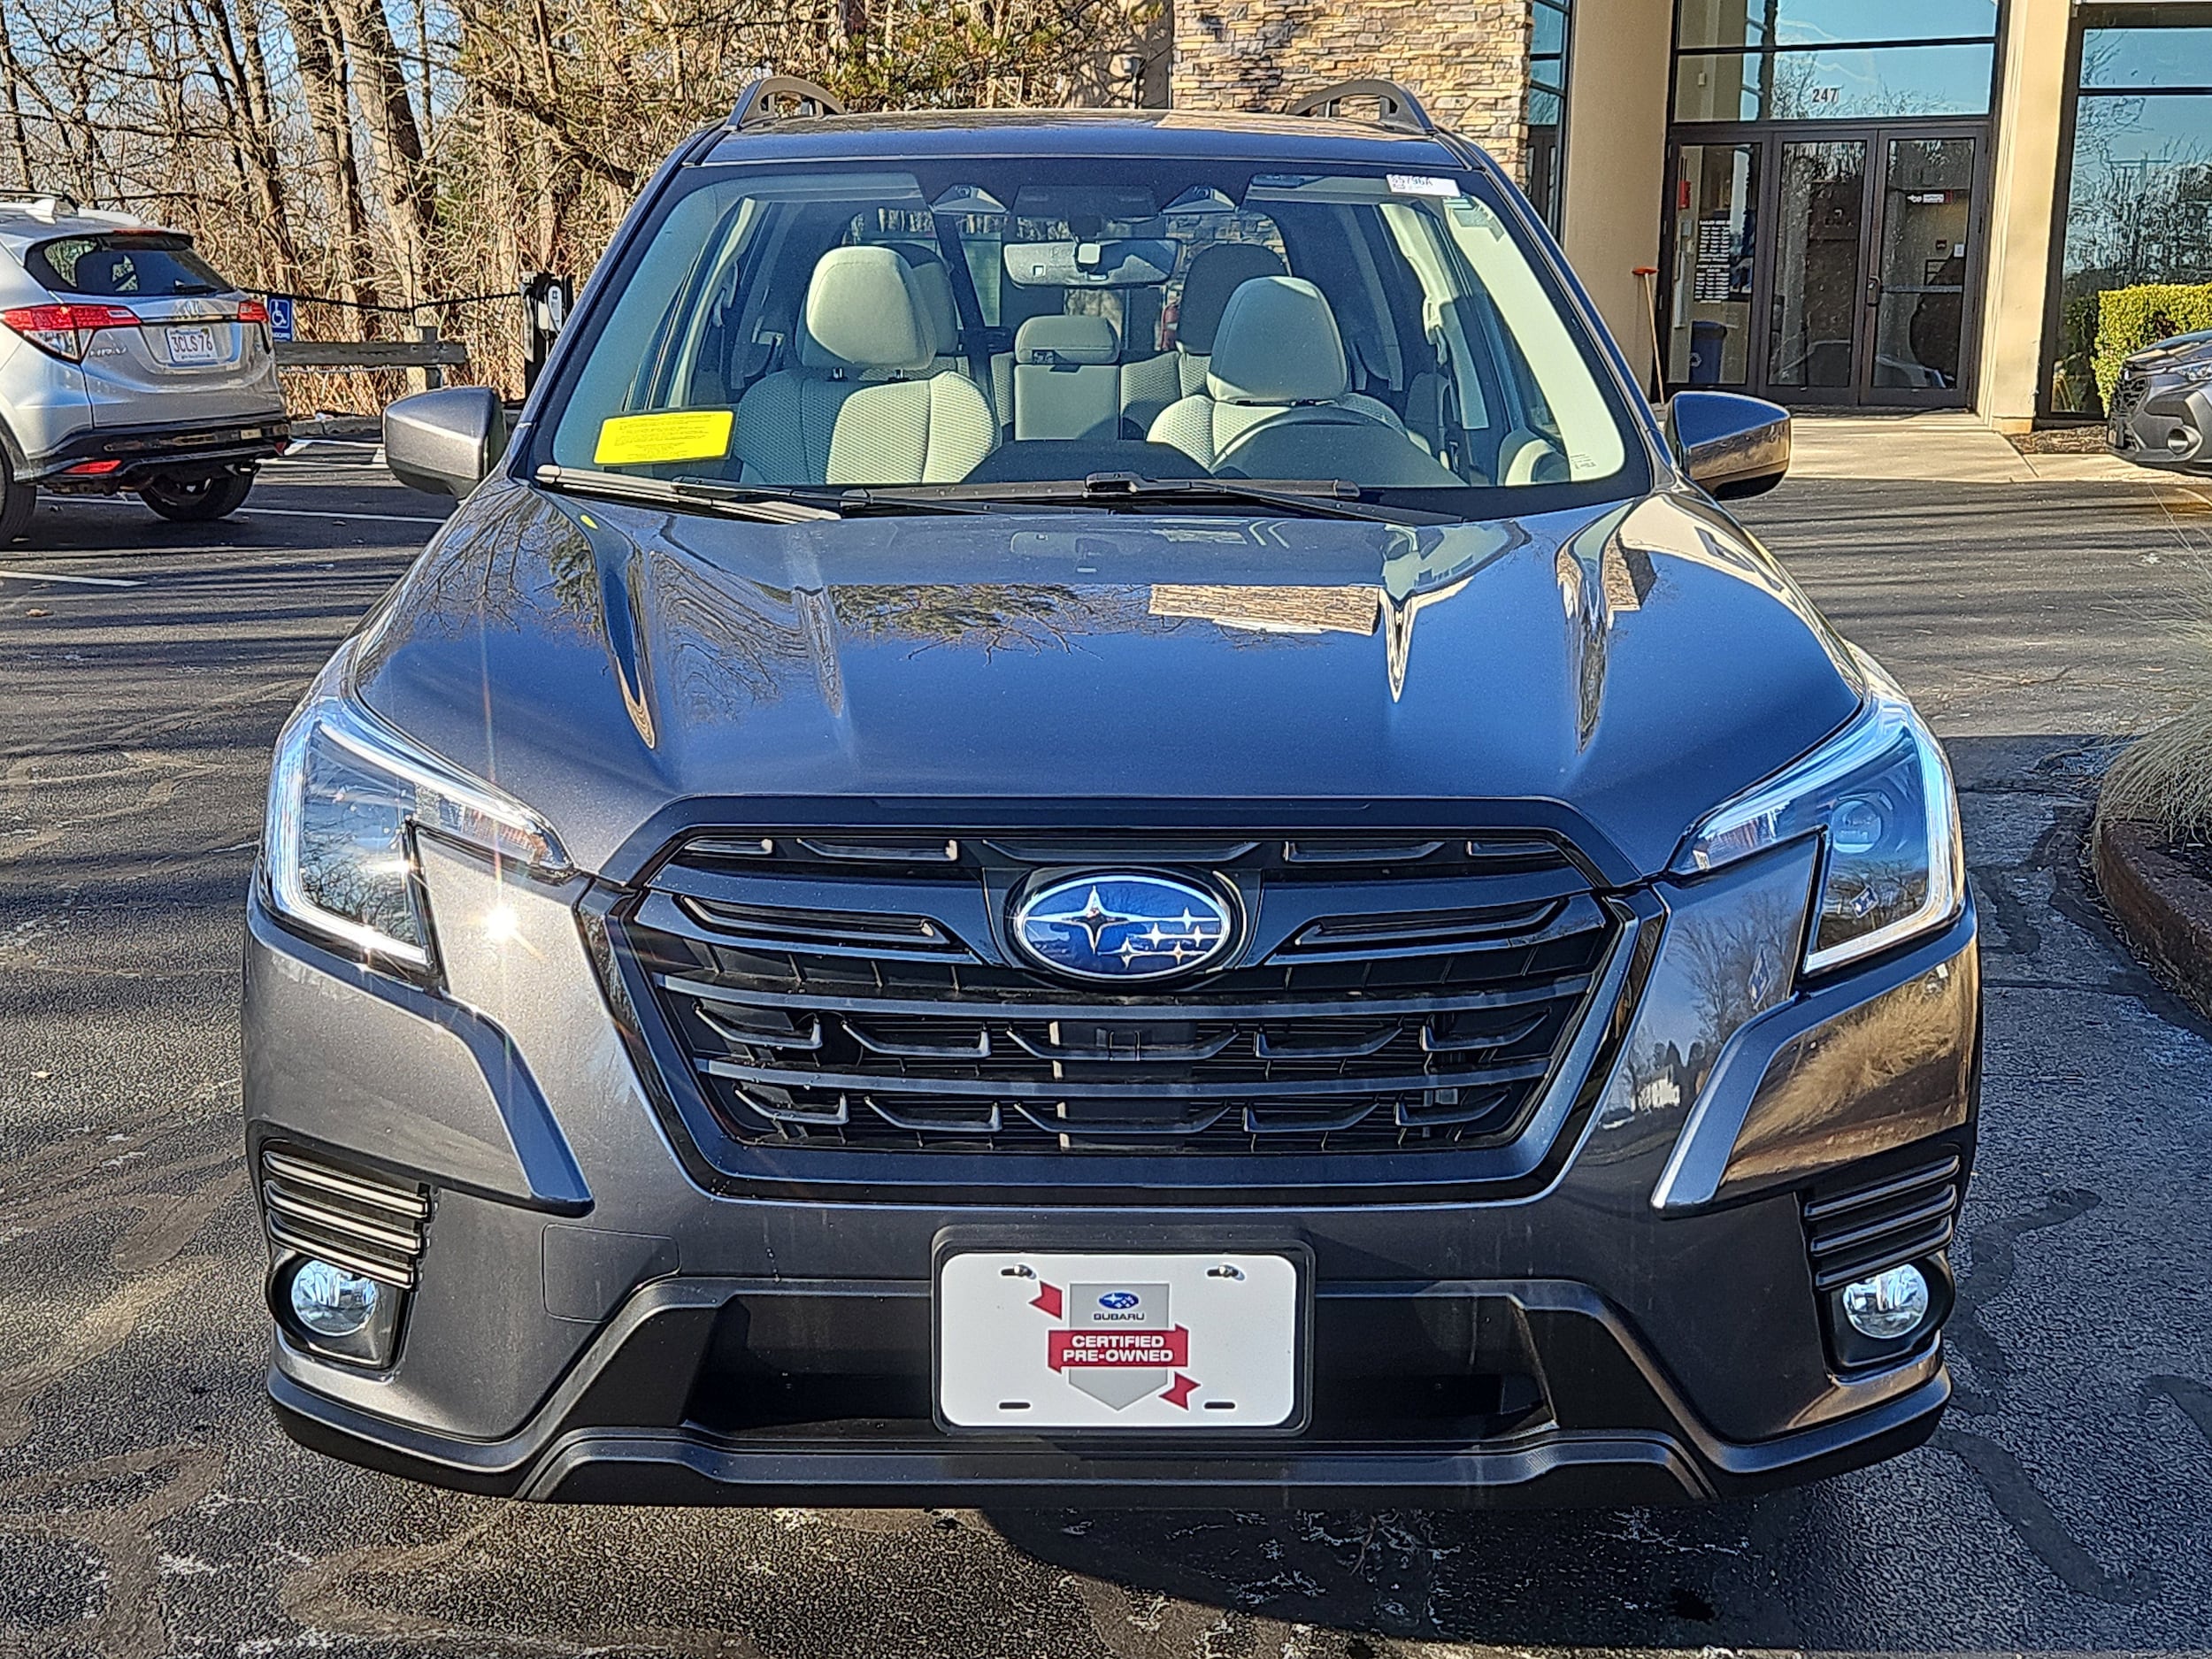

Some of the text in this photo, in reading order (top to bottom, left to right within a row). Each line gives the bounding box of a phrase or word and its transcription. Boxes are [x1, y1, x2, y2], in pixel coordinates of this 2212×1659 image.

[1812, 88, 1839, 104] 247
[171, 333, 213, 352] 3CLS76
[1071, 1335, 1165, 1348] CERTIFIED
[1063, 1349, 1174, 1363] PRE-OWNED
